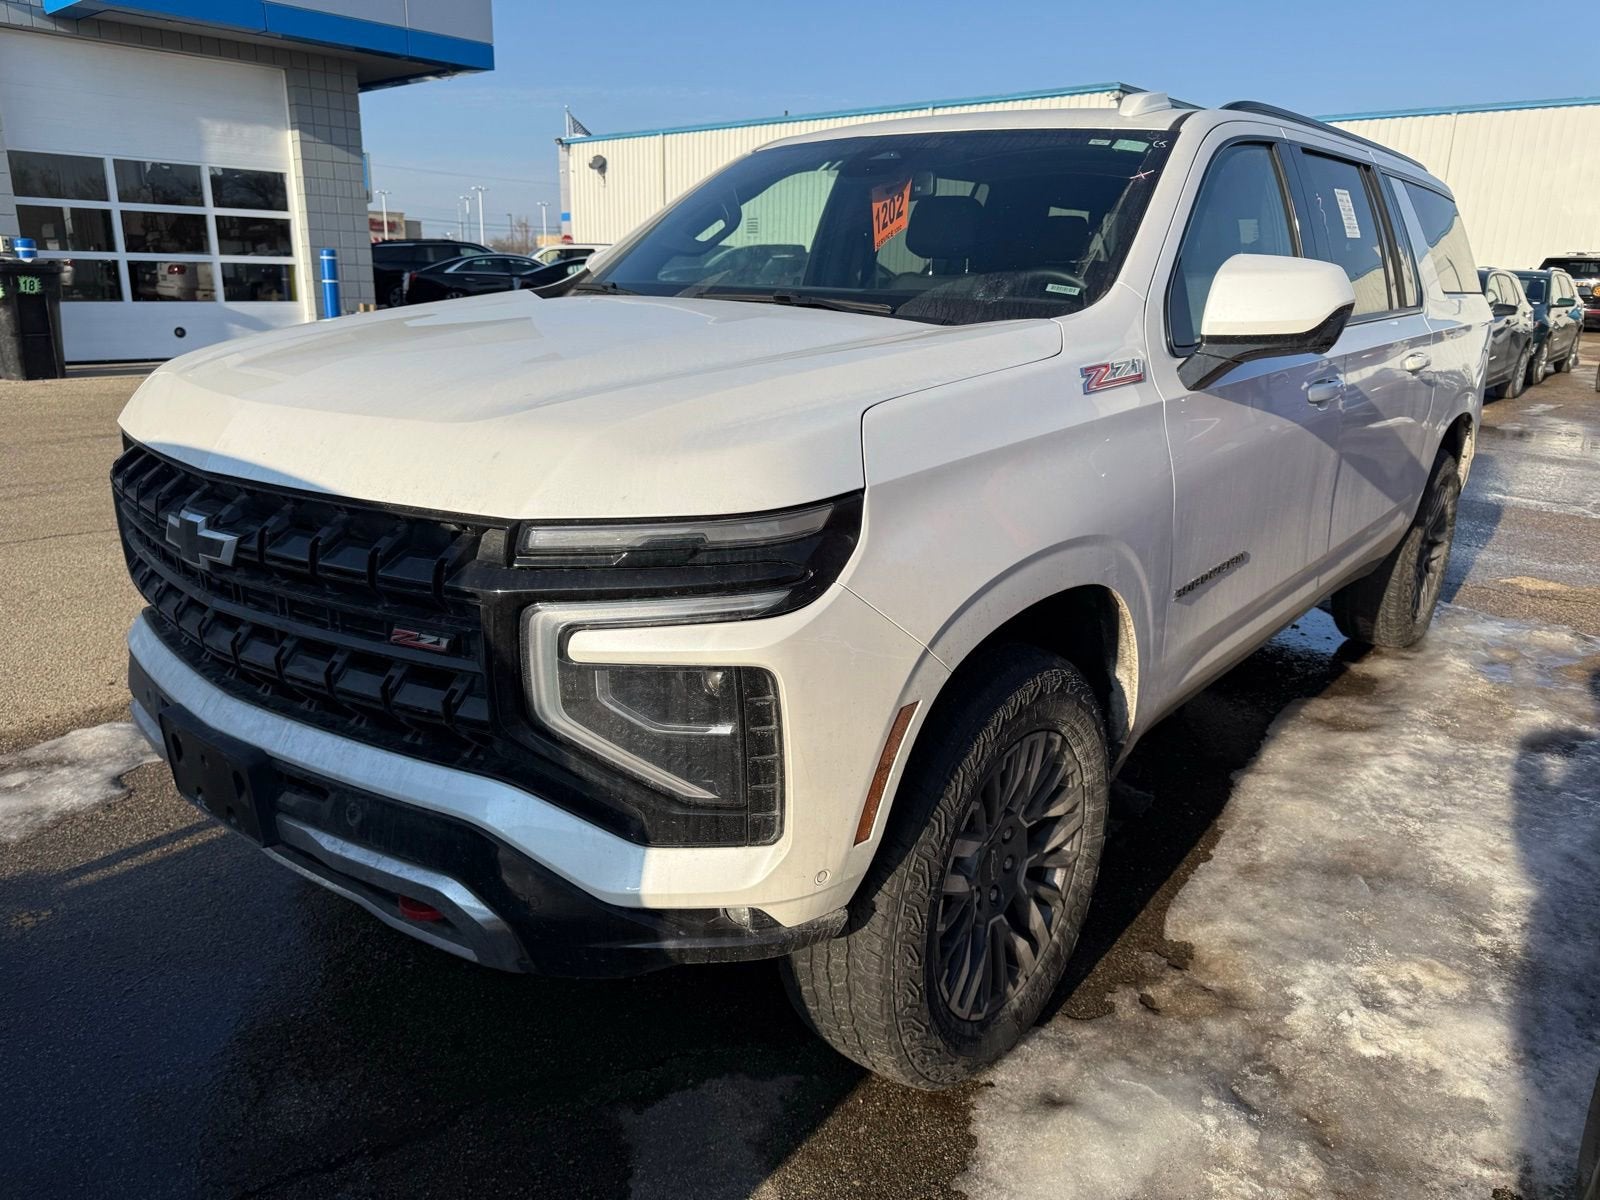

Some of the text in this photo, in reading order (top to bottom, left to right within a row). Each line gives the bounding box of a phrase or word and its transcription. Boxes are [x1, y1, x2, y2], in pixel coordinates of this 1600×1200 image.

[876, 192, 904, 234] 1202
[22, 280, 35, 291] 18
[1079, 357, 1147, 395] Z71
[390, 627, 450, 652] Z71
